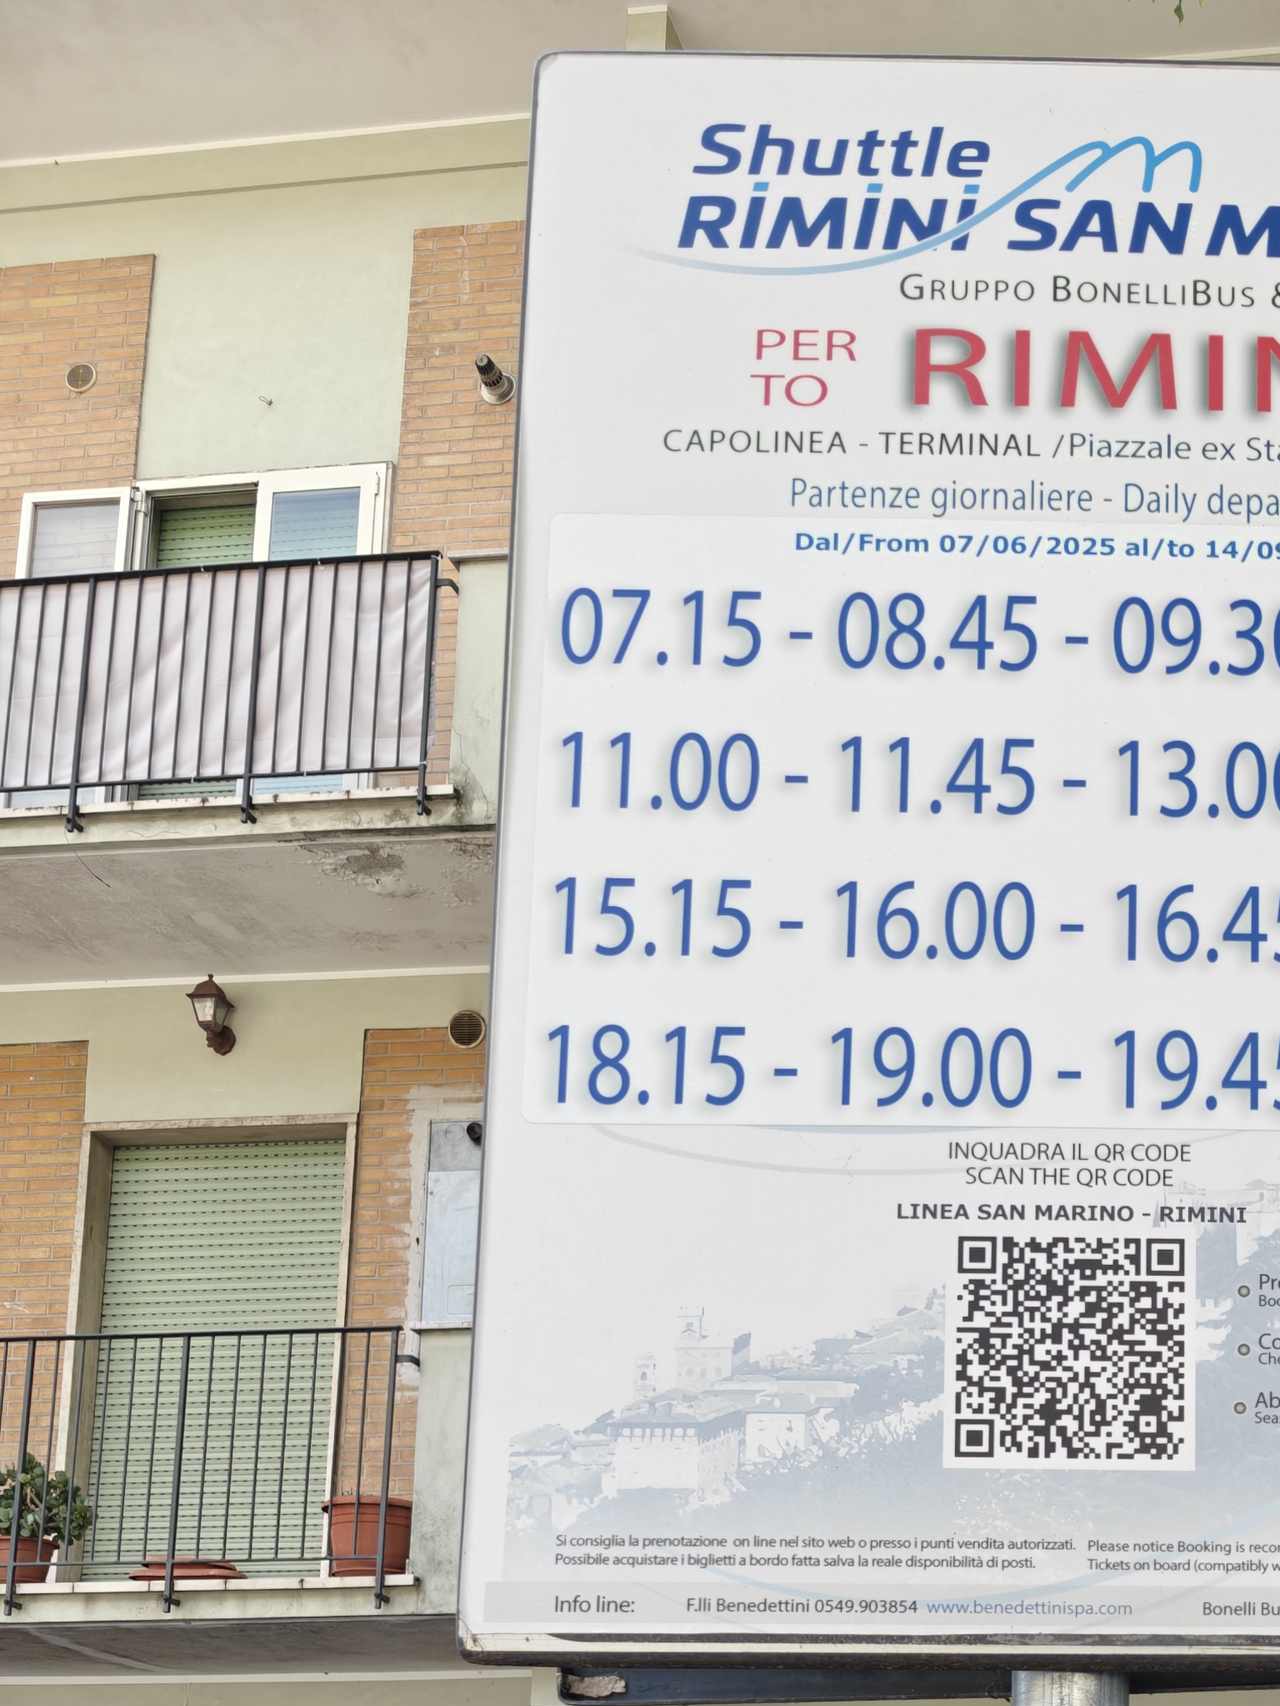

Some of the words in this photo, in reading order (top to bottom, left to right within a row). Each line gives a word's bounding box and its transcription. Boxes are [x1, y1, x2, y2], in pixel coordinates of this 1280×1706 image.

[692, 123, 991, 178] Shuttle
[1007, 199, 1193, 255] SAN
[756, 328, 856, 361] PER
[749, 374, 827, 406] TO
[663, 429, 846, 453] CAPOLINEA
[878, 431, 1040, 456] TERMINAL
[1201, 442, 1235, 460] ex
[791, 477, 920, 508] Partenze
[931, 479, 1092, 517] giornaliere
[1124, 482, 1196, 522] Daily
[795, 532, 928, 554] Dal/From
[939, 534, 1115, 557] 07/06/2025
[1125, 537, 1194, 560] al/to
[561, 587, 761, 667] 07.15
[837, 591, 1037, 671] 08.45
[562, 731, 759, 811] 11.00
[841, 735, 1035, 816] 11.45
[555, 876, 751, 957] 15.15
[836, 880, 1035, 960] 16.00
[548, 1024, 745, 1106] 18.15
[831, 1026, 1032, 1108] 19.00
[949, 1141, 1065, 1161] INQUADRA
[1072, 1142, 1088, 1160] IL
[1094, 1143, 1124, 1163] QR
[1130, 1143, 1191, 1161] CODE
[965, 1166, 1023, 1184] SCAN
[1028, 1167, 1069, 1185] THE
[1076, 1167, 1106, 1187] QR
[1112, 1168, 1173, 1186] CODE
[897, 1203, 969, 1219] LINEA
[977, 1203, 1025, 1220] SAN
[1034, 1204, 1134, 1221] MARINO
[1159, 1205, 1246, 1223] RIMINI
[1087, 1539, 1129, 1551] Please
[1133, 1541, 1174, 1552] notice
[1177, 1540, 1231, 1555] Booking
[1235, 1543, 1245, 1552] is
[554, 1594, 591, 1612] Info
[596, 1594, 634, 1612] line:
[686, 1597, 710, 1611] F.lli
[716, 1597, 809, 1612] Benedettini
[814, 1599, 918, 1613] 0549.903854
[926, 1599, 1132, 1618] www.benedettinispa.com
[1202, 1601, 1255, 1615] Bonelli
